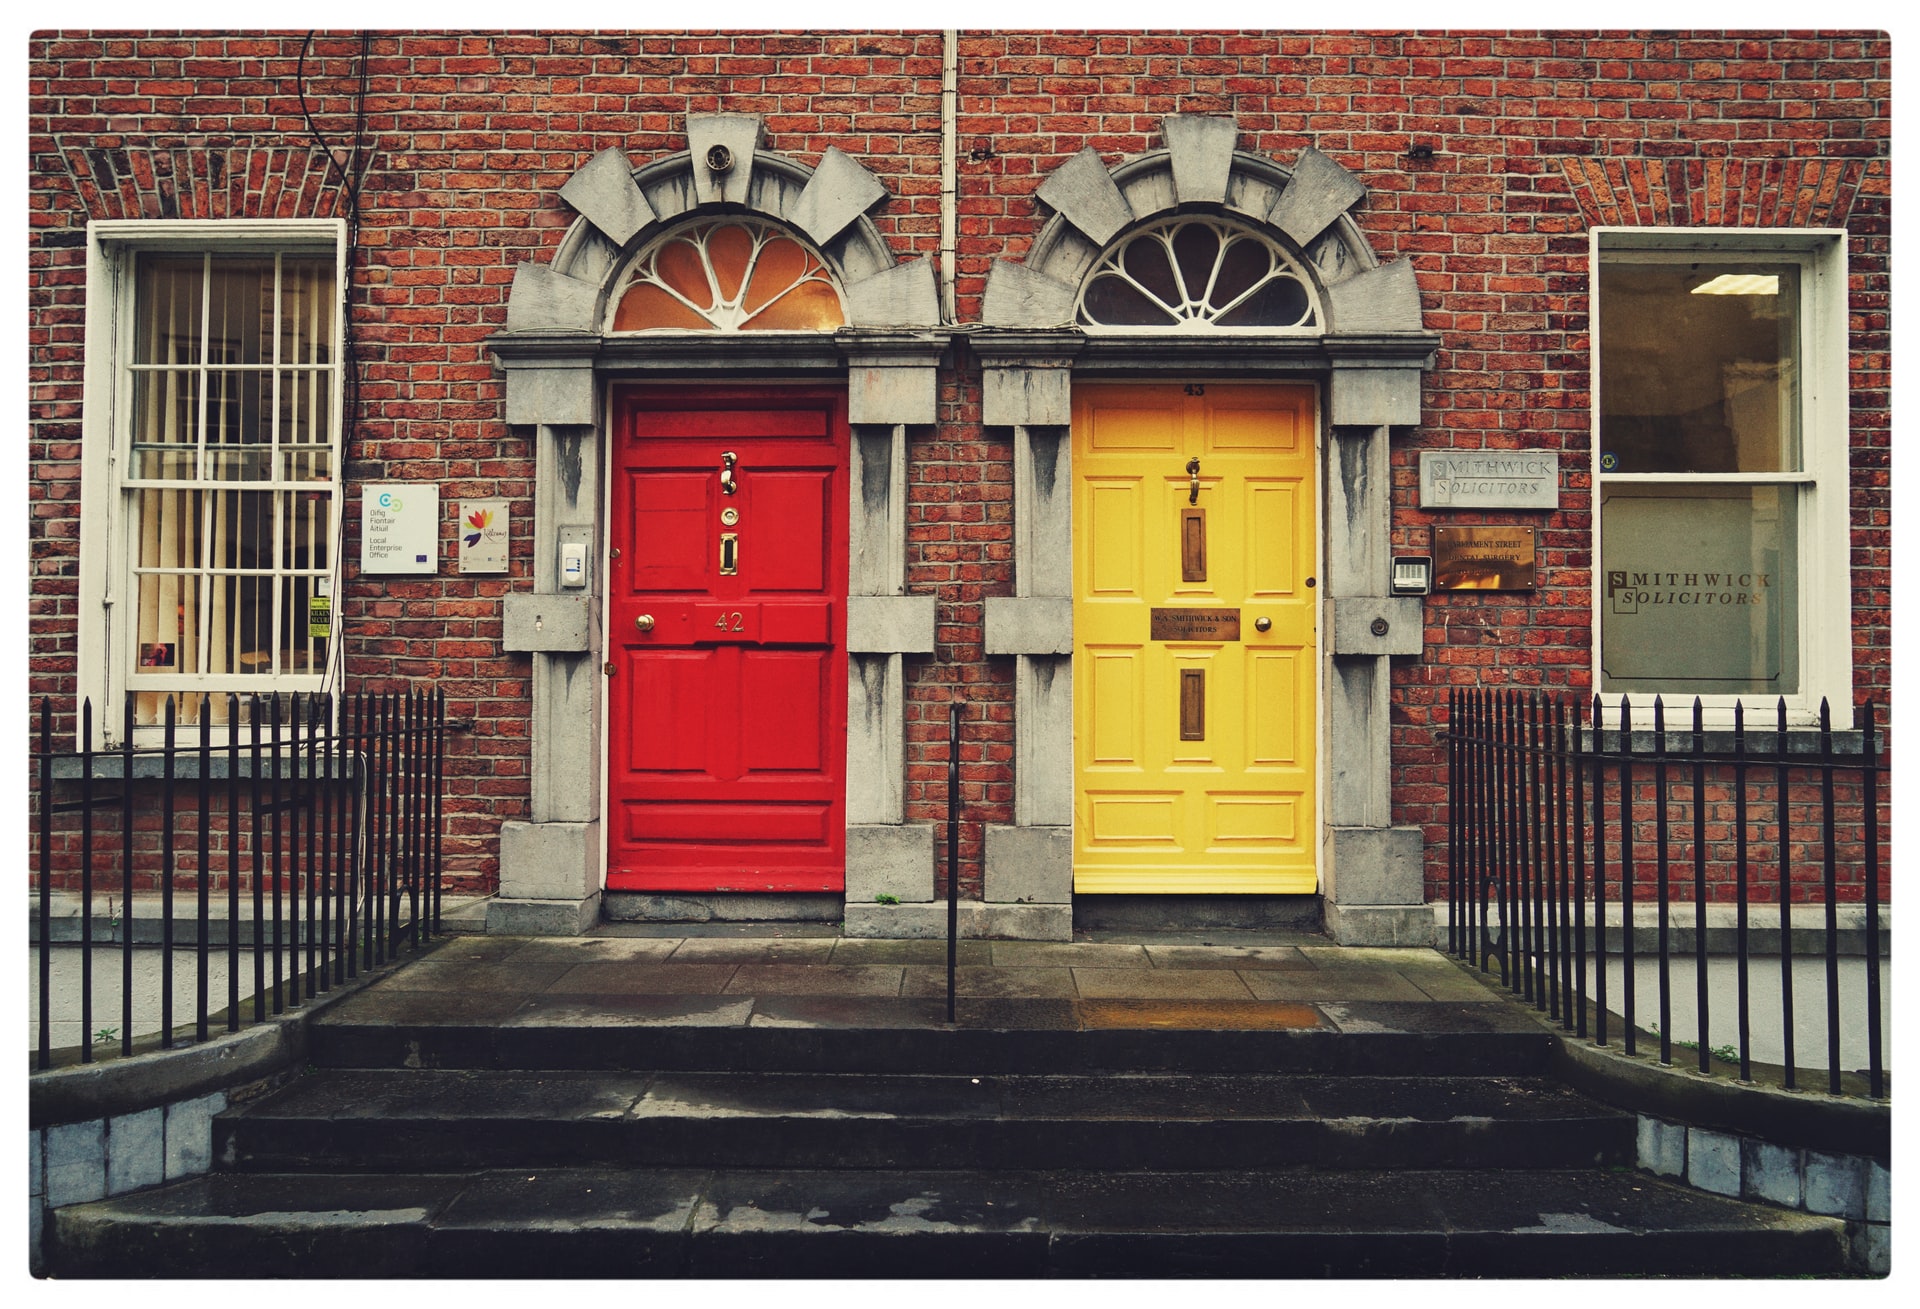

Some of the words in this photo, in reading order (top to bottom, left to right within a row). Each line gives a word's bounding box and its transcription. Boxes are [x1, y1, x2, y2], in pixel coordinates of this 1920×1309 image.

[1183, 384, 1205, 396] 43
[1432, 460, 1552, 477] SMITHWICK
[1438, 481, 1539, 494] SOLICITORS
[369, 509, 386, 517] Oifig
[369, 544, 403, 552] Enterprise
[1495, 540, 1522, 548] STREET
[1612, 572, 1770, 587] SMITHWICK
[1622, 592, 1762, 604] SOLICITORS
[714, 611, 745, 632] 42
